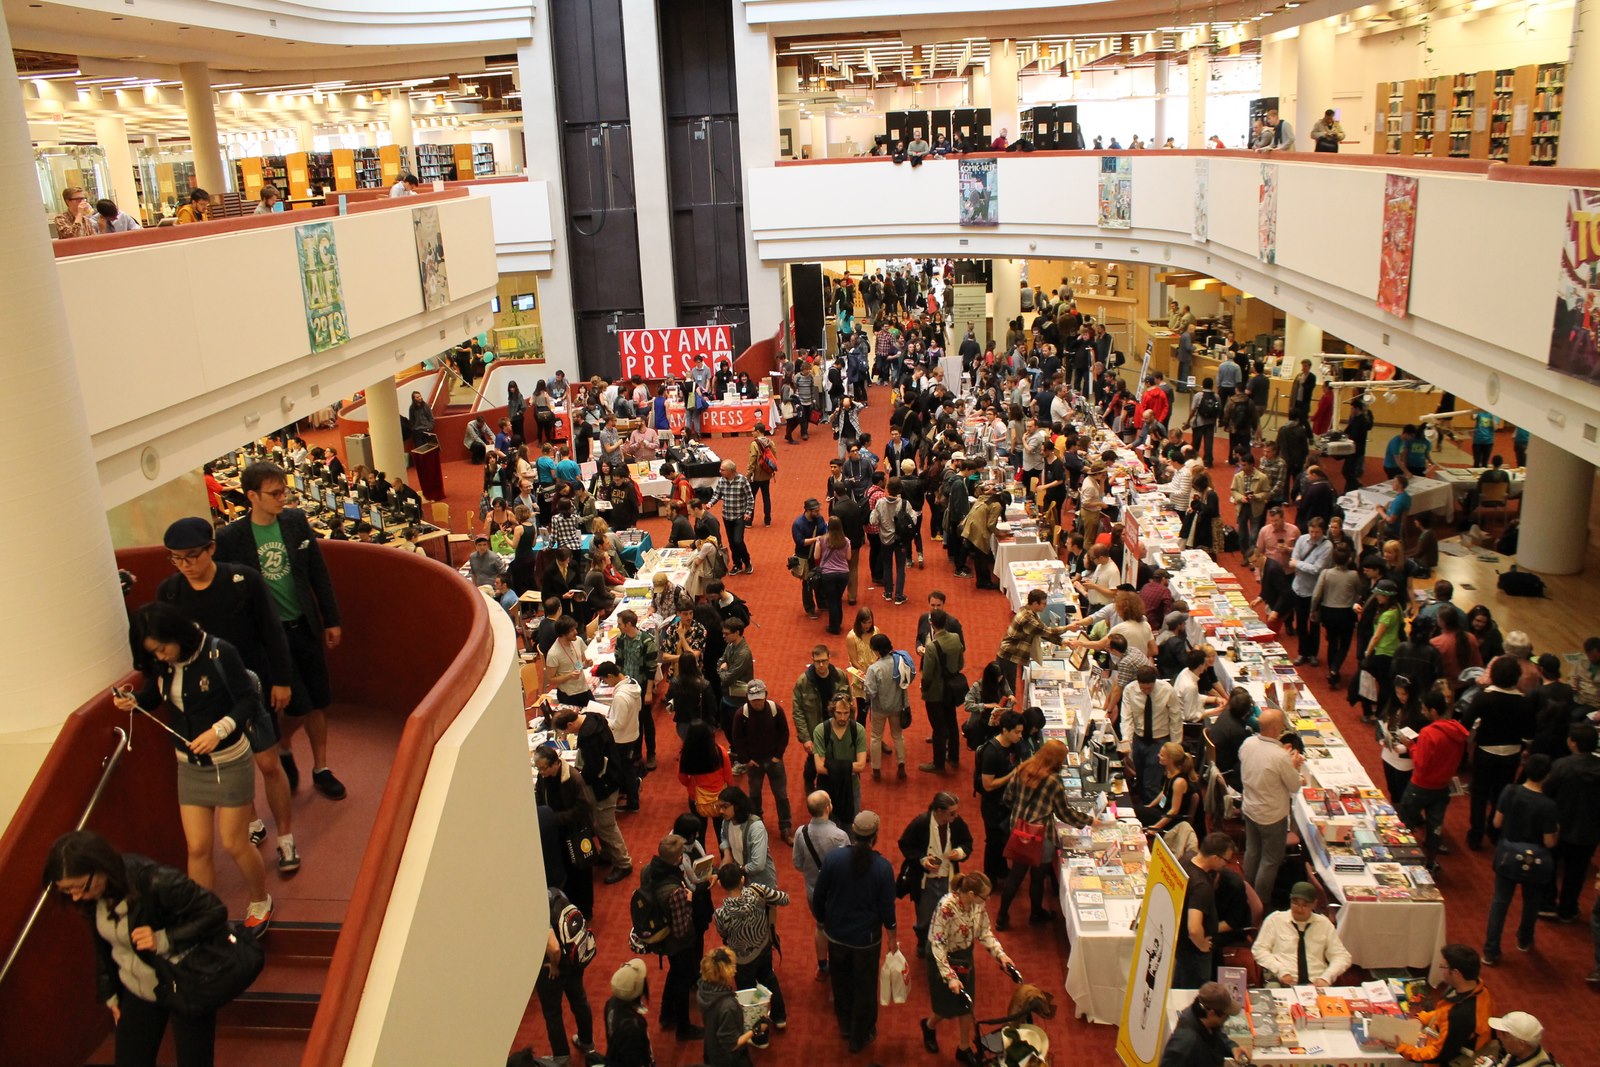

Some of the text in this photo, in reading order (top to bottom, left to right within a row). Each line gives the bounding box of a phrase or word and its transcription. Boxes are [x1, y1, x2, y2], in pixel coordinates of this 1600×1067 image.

[313, 311, 345, 346] 2013
[622, 327, 729, 355] KOYAMA
[702, 410, 744, 426] PRESS
[264, 550, 282, 568] 25
